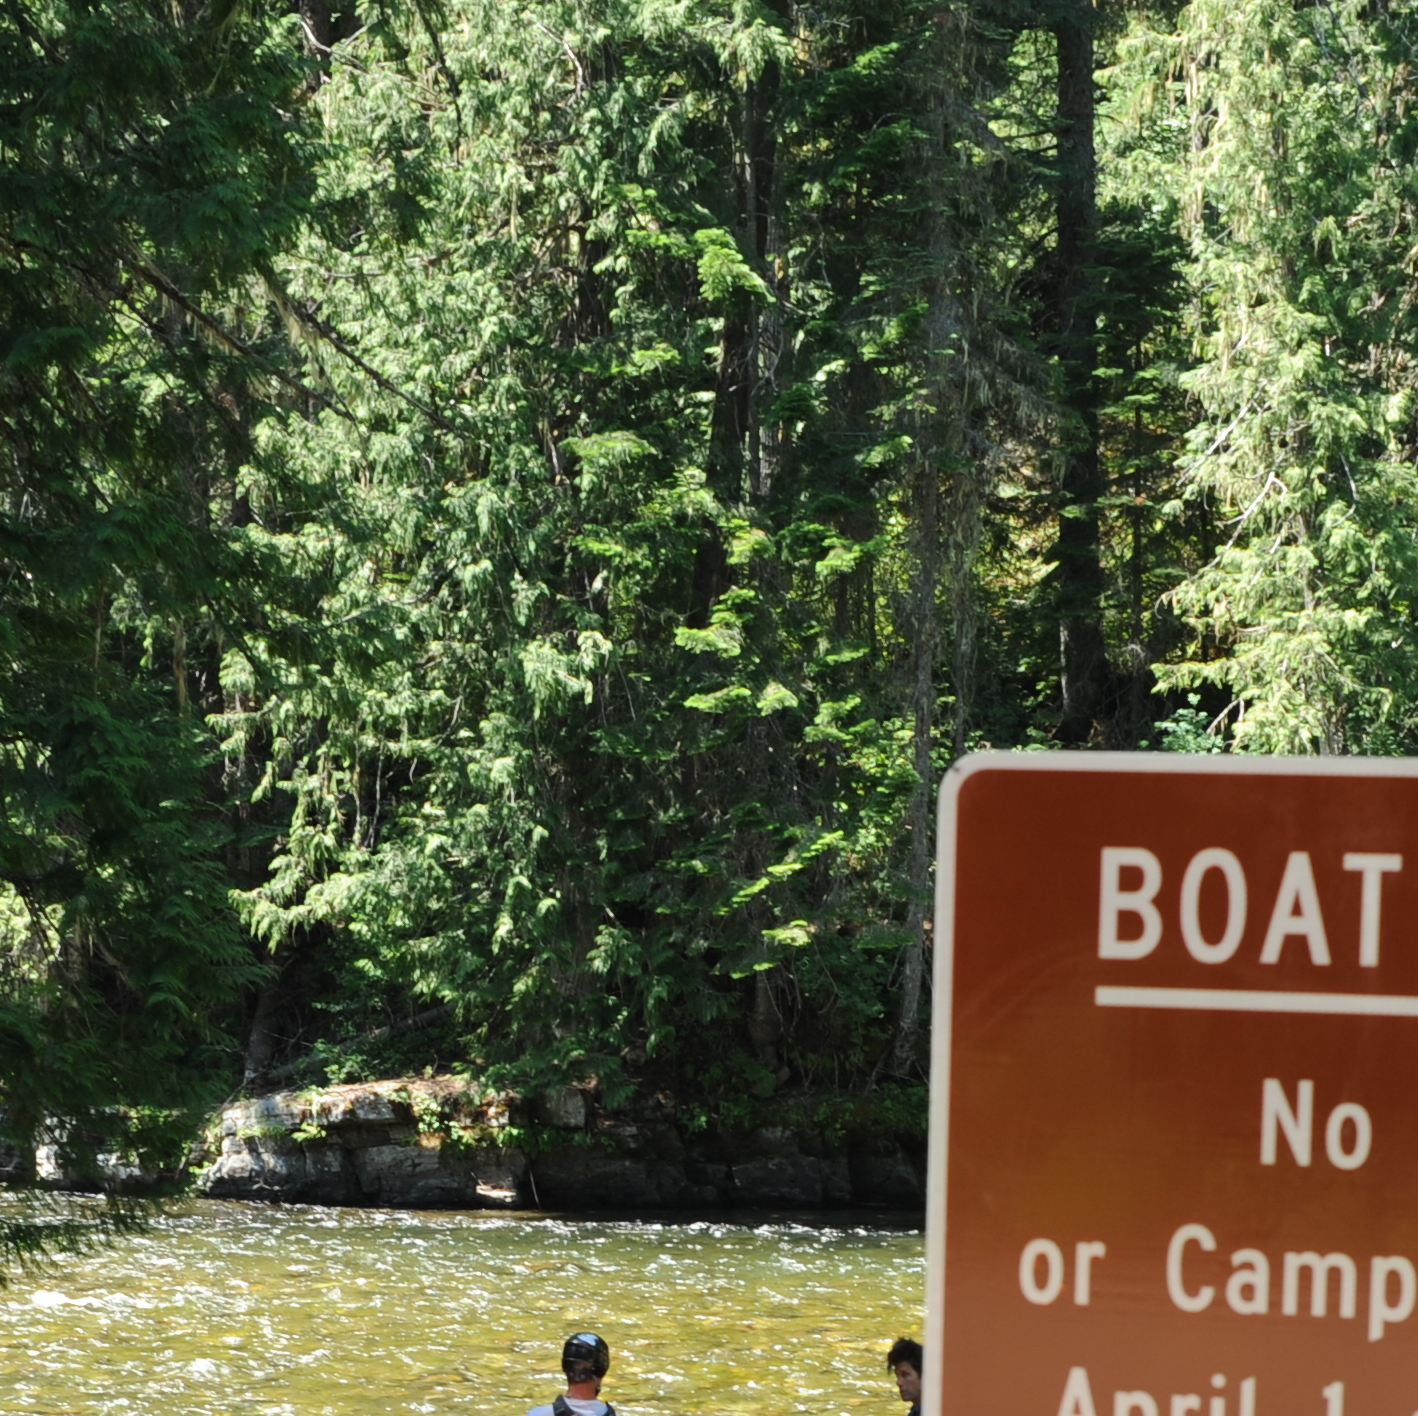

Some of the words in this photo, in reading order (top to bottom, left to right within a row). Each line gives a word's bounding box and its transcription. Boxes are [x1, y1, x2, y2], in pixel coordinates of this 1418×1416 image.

[1098, 847, 1402, 967] BOAT
[1260, 1078, 1371, 1170] No
[1019, 1238, 1106, 1306] or
